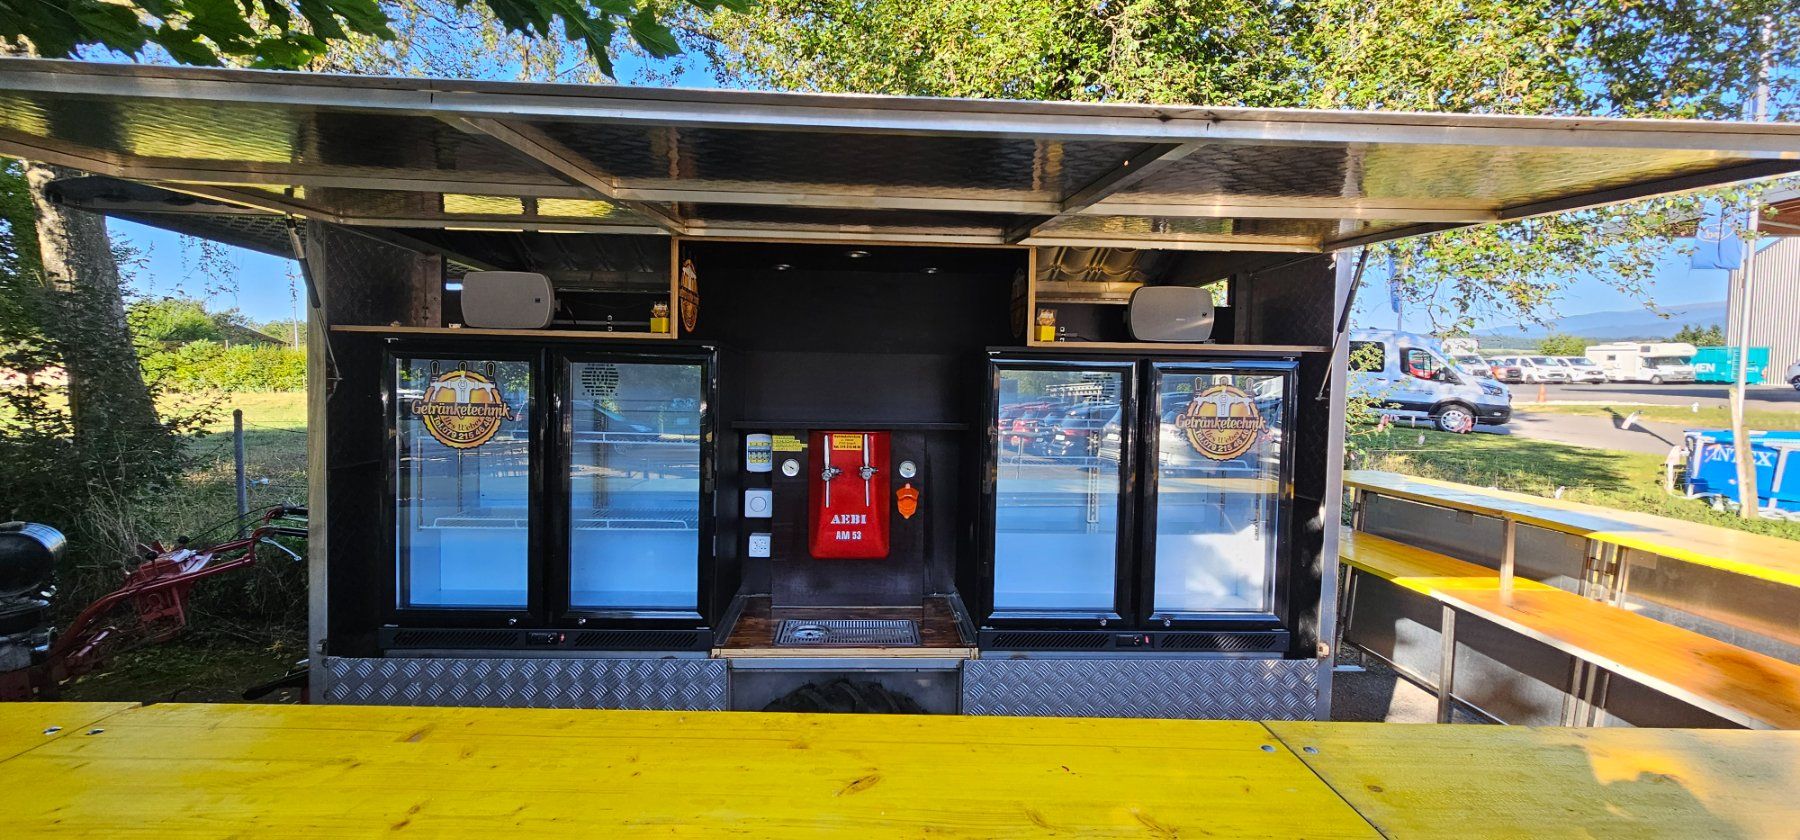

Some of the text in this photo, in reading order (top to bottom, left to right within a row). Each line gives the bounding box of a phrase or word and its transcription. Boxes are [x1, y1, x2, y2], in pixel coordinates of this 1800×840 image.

[411, 399, 514, 421] Getränketechnik
[458, 418, 483, 431] Weber
[1175, 413, 1269, 434] Getränketechnik
[458, 432, 475, 440] 215
[1217, 444, 1233, 452] 215
[830, 514, 867, 524] AEBI
[836, 531, 862, 540] AM 53
